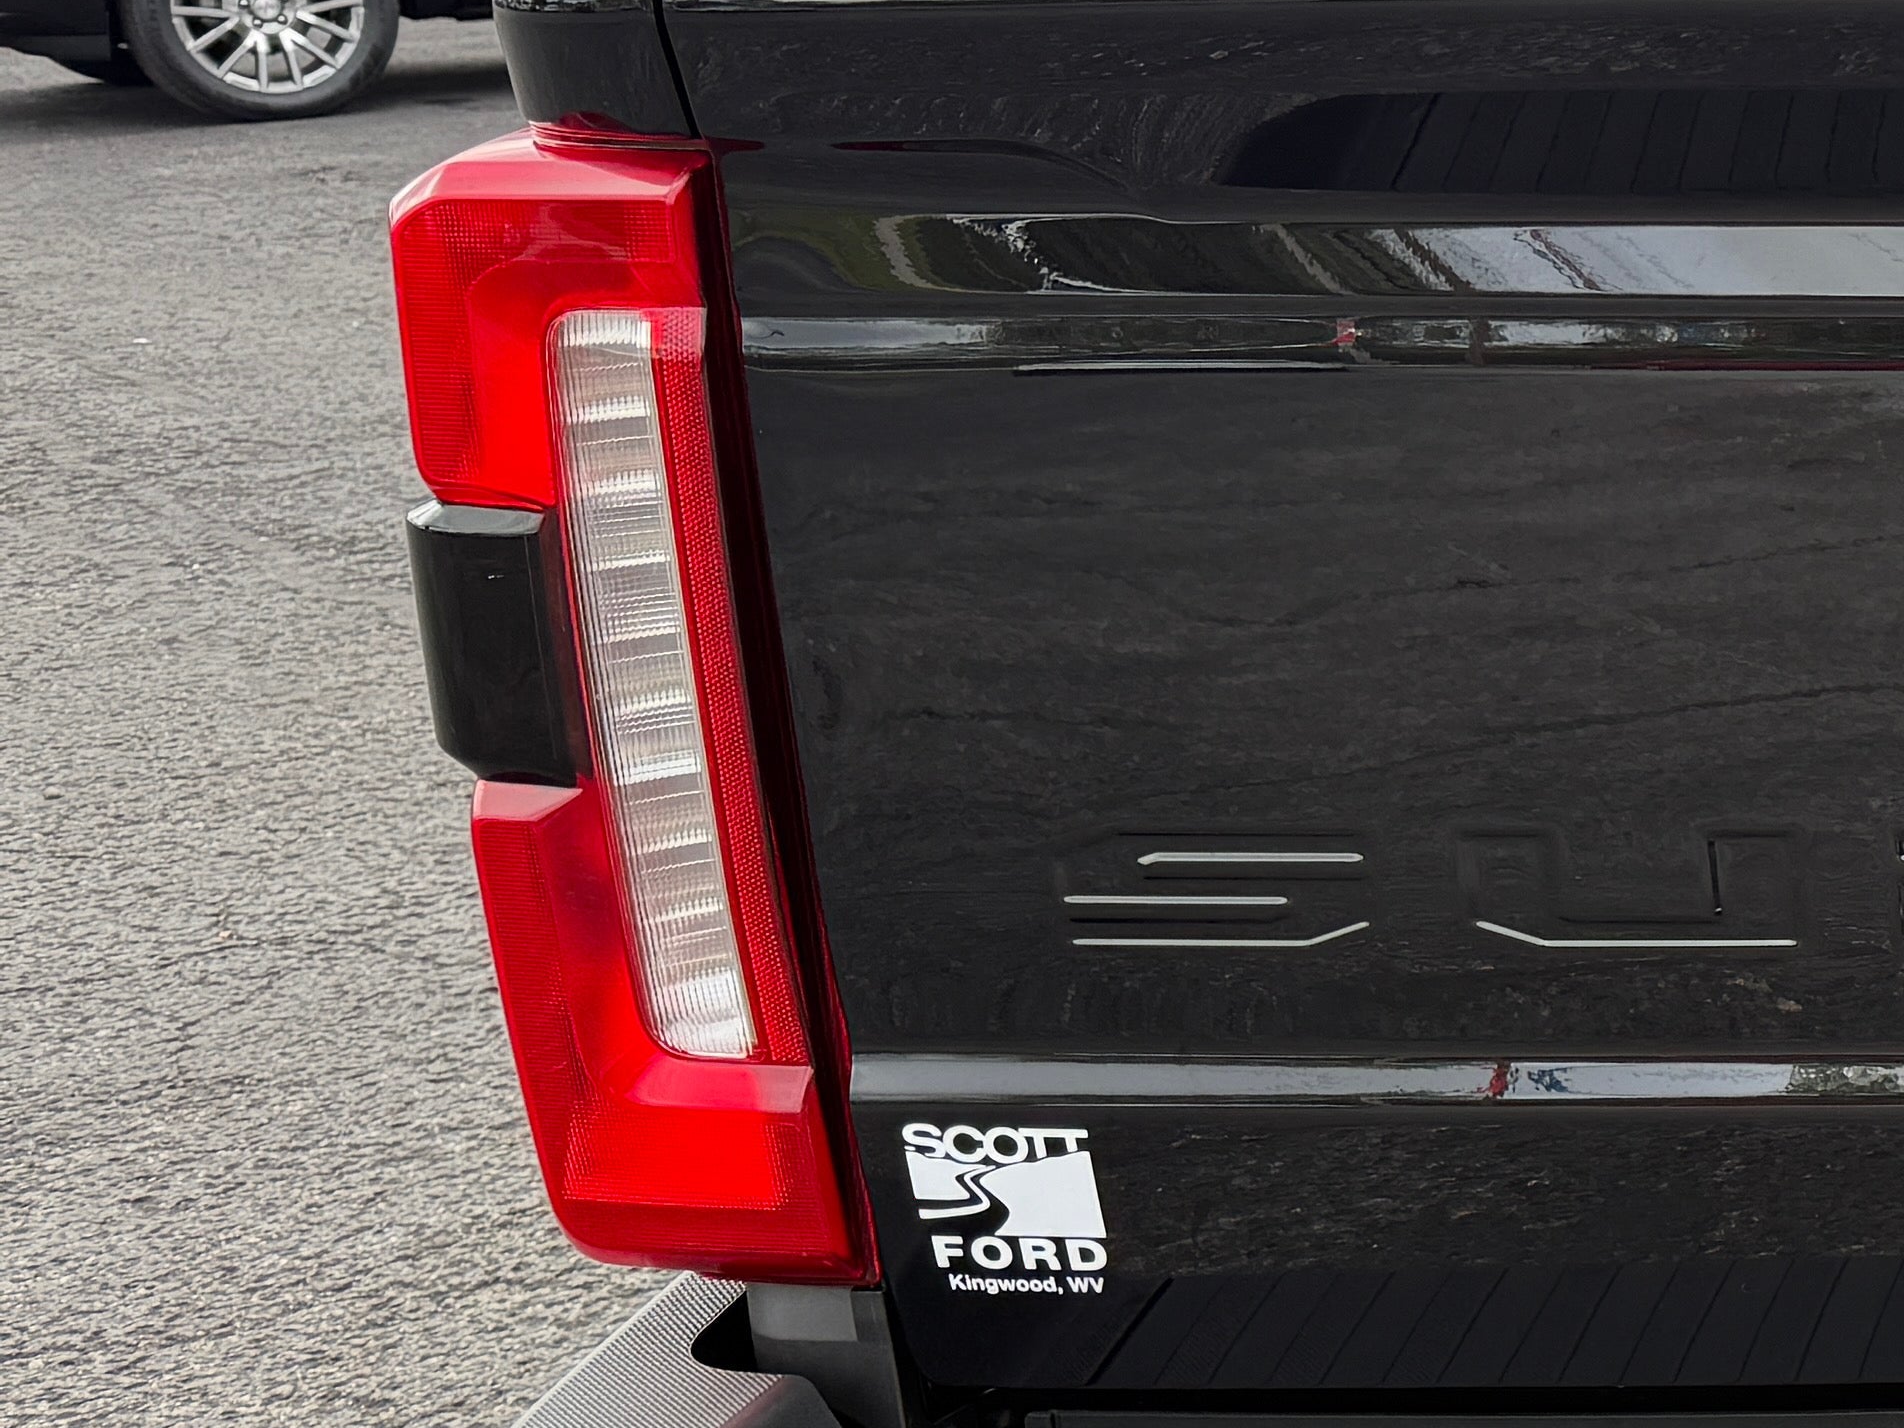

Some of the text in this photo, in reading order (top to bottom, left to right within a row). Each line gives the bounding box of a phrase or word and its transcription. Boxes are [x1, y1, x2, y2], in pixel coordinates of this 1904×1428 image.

[902, 1123, 1088, 1164] SCOTT
[931, 1235, 1107, 1272] FORD
[949, 1273, 1104, 1295] Kingwood, WV
